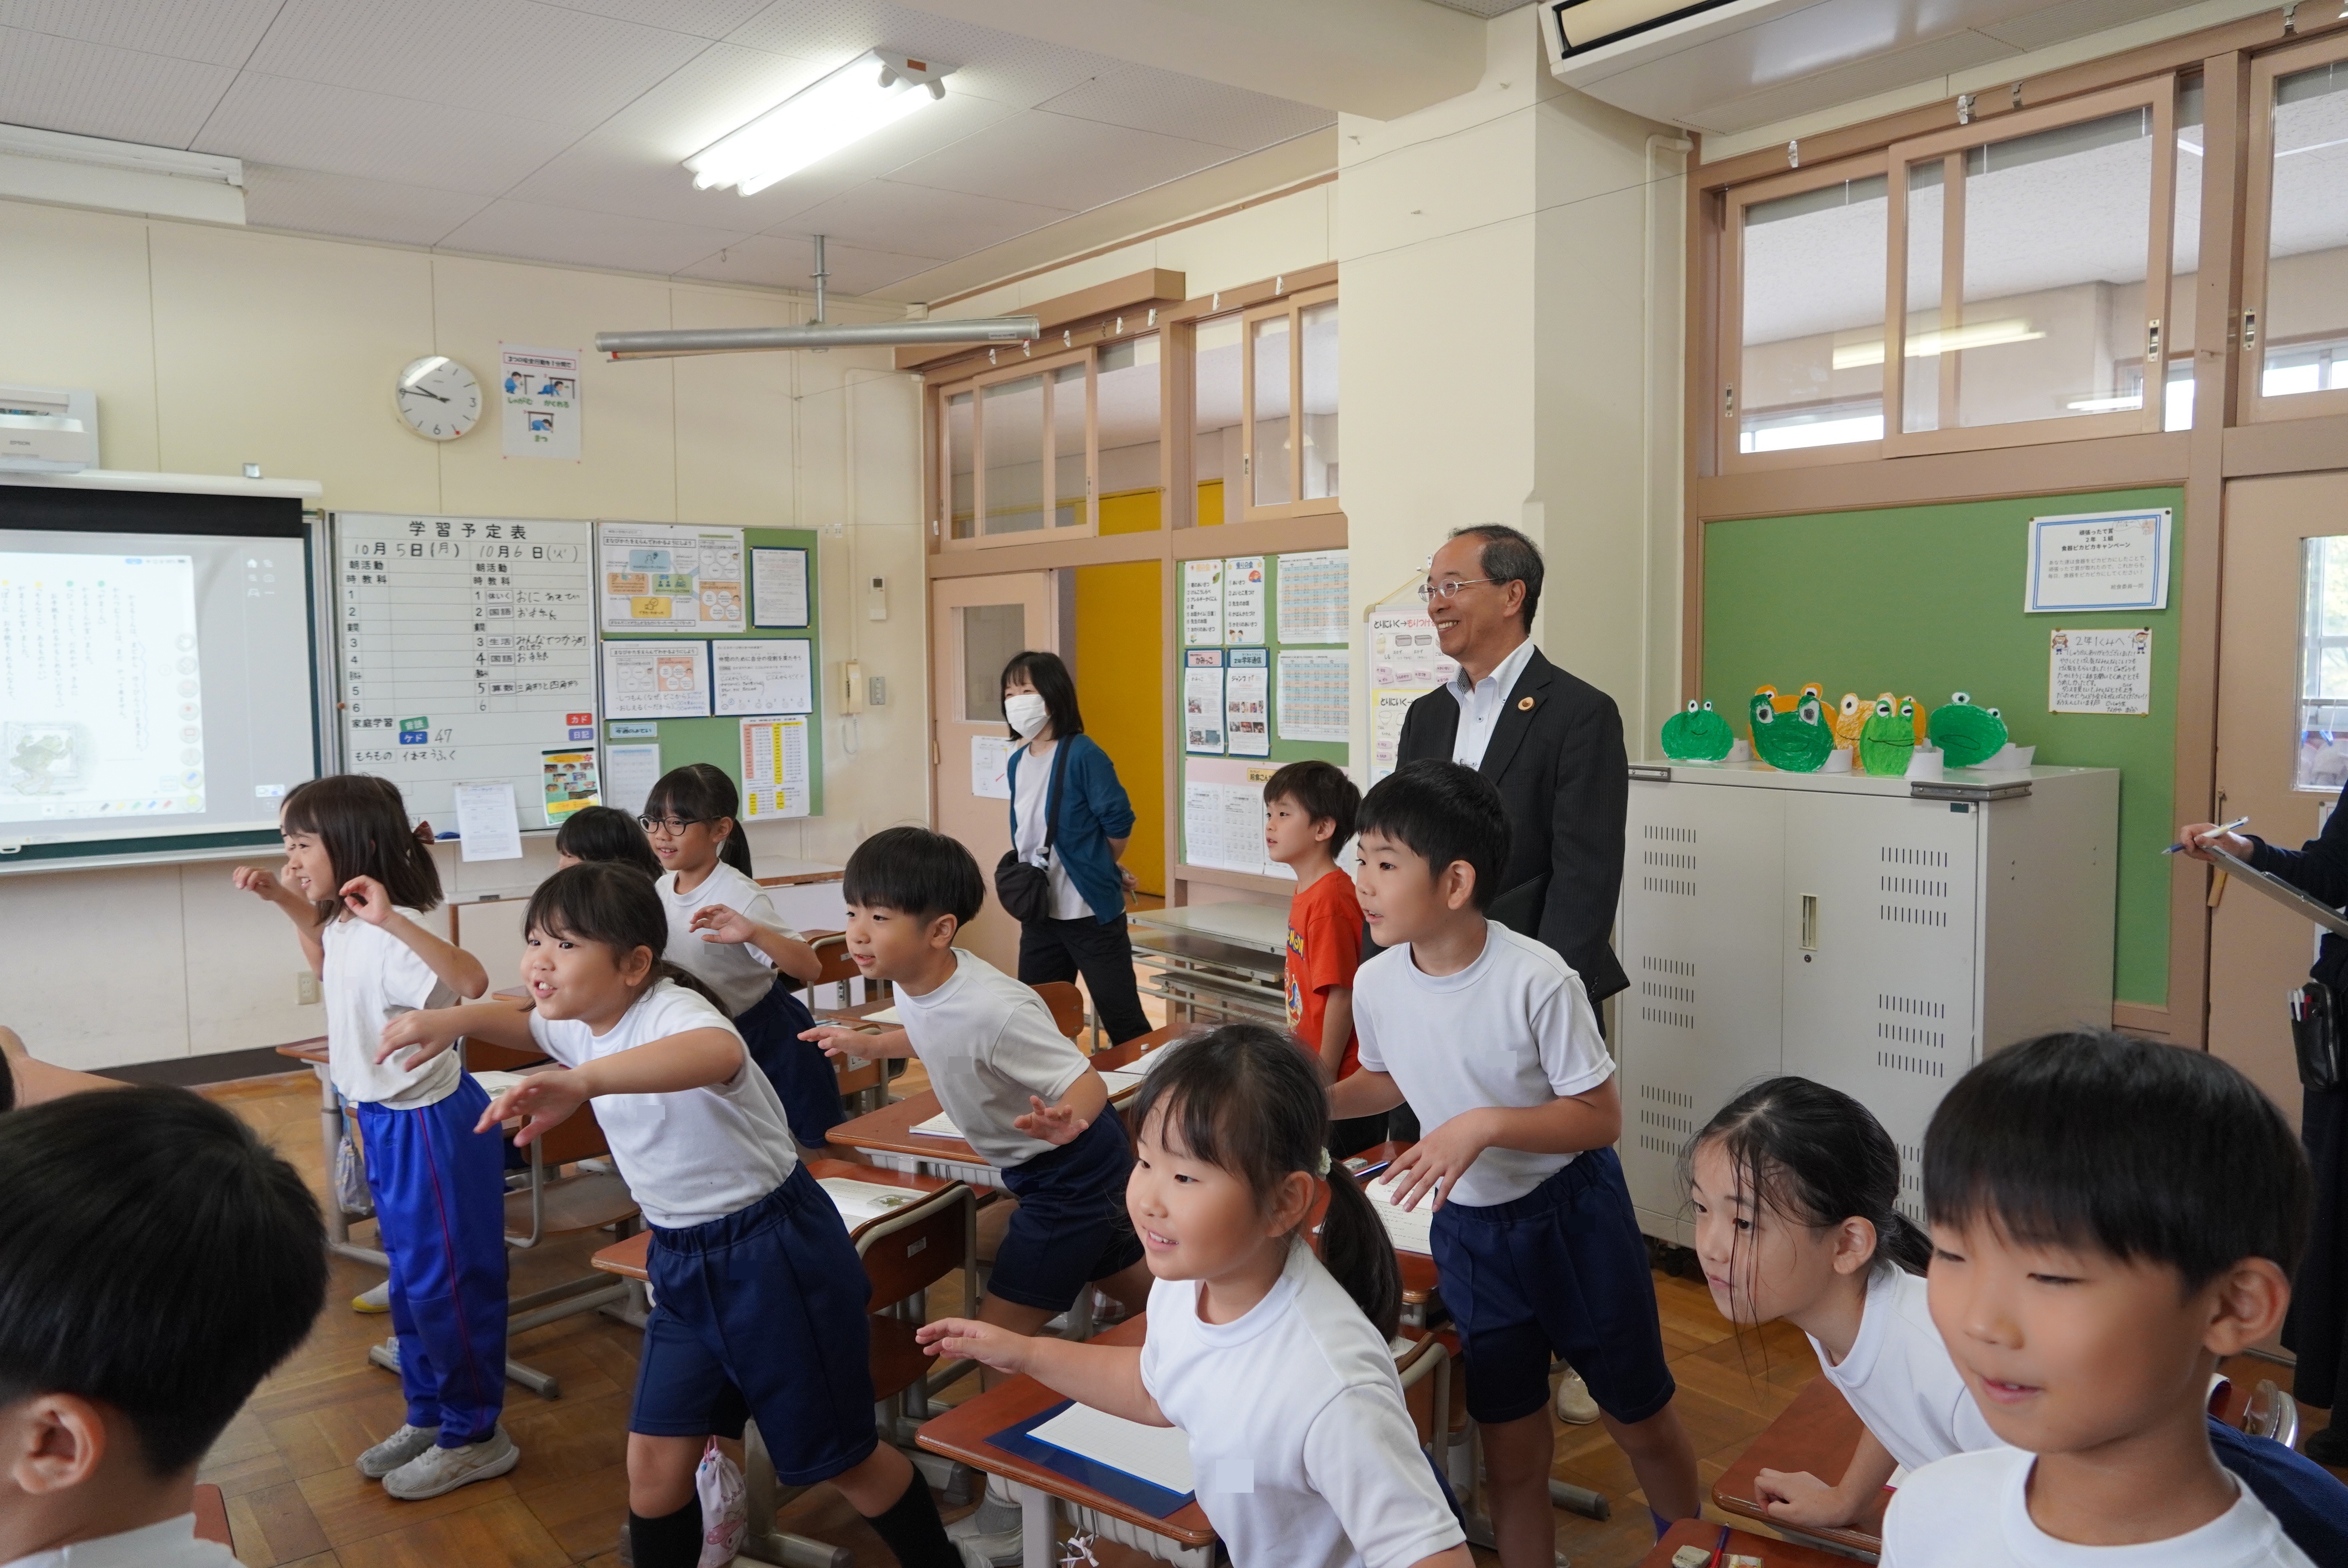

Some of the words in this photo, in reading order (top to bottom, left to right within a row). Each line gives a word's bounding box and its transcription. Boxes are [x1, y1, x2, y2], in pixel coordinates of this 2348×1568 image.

[470, 398, 476, 408] 3
[544, 400, 569, 408] かくれる
[433, 424, 441, 435] 6
[409, 521, 526, 539] 学習予定表
[349, 561, 383, 570] 朝活動
[476, 564, 507, 573] 朝活動
[346, 575, 356, 584] 時
[362, 575, 387, 584] 教科
[473, 576, 482, 585] 時
[488, 576, 510, 585] 教科
[348, 590, 353, 599] 1
[475, 591, 481, 600] 1
[348, 607, 356, 616] 2
[476, 608, 482, 616] 2
[1374, 620, 1400, 629] とりにいく
[350, 639, 357, 647] 3
[476, 637, 484, 647] 3
[476, 652, 486, 665] 4
[352, 687, 359, 695] 5
[478, 683, 485, 694] 5
[479, 700, 486, 711] 6
[1381, 698, 1407, 706] とりにいく
[353, 704, 360, 712] 6
[352, 718, 393, 728] 家庭学習
[435, 729, 452, 742] 47
[573, 730, 590, 739] 日記
[355, 752, 392, 761] もちもの
